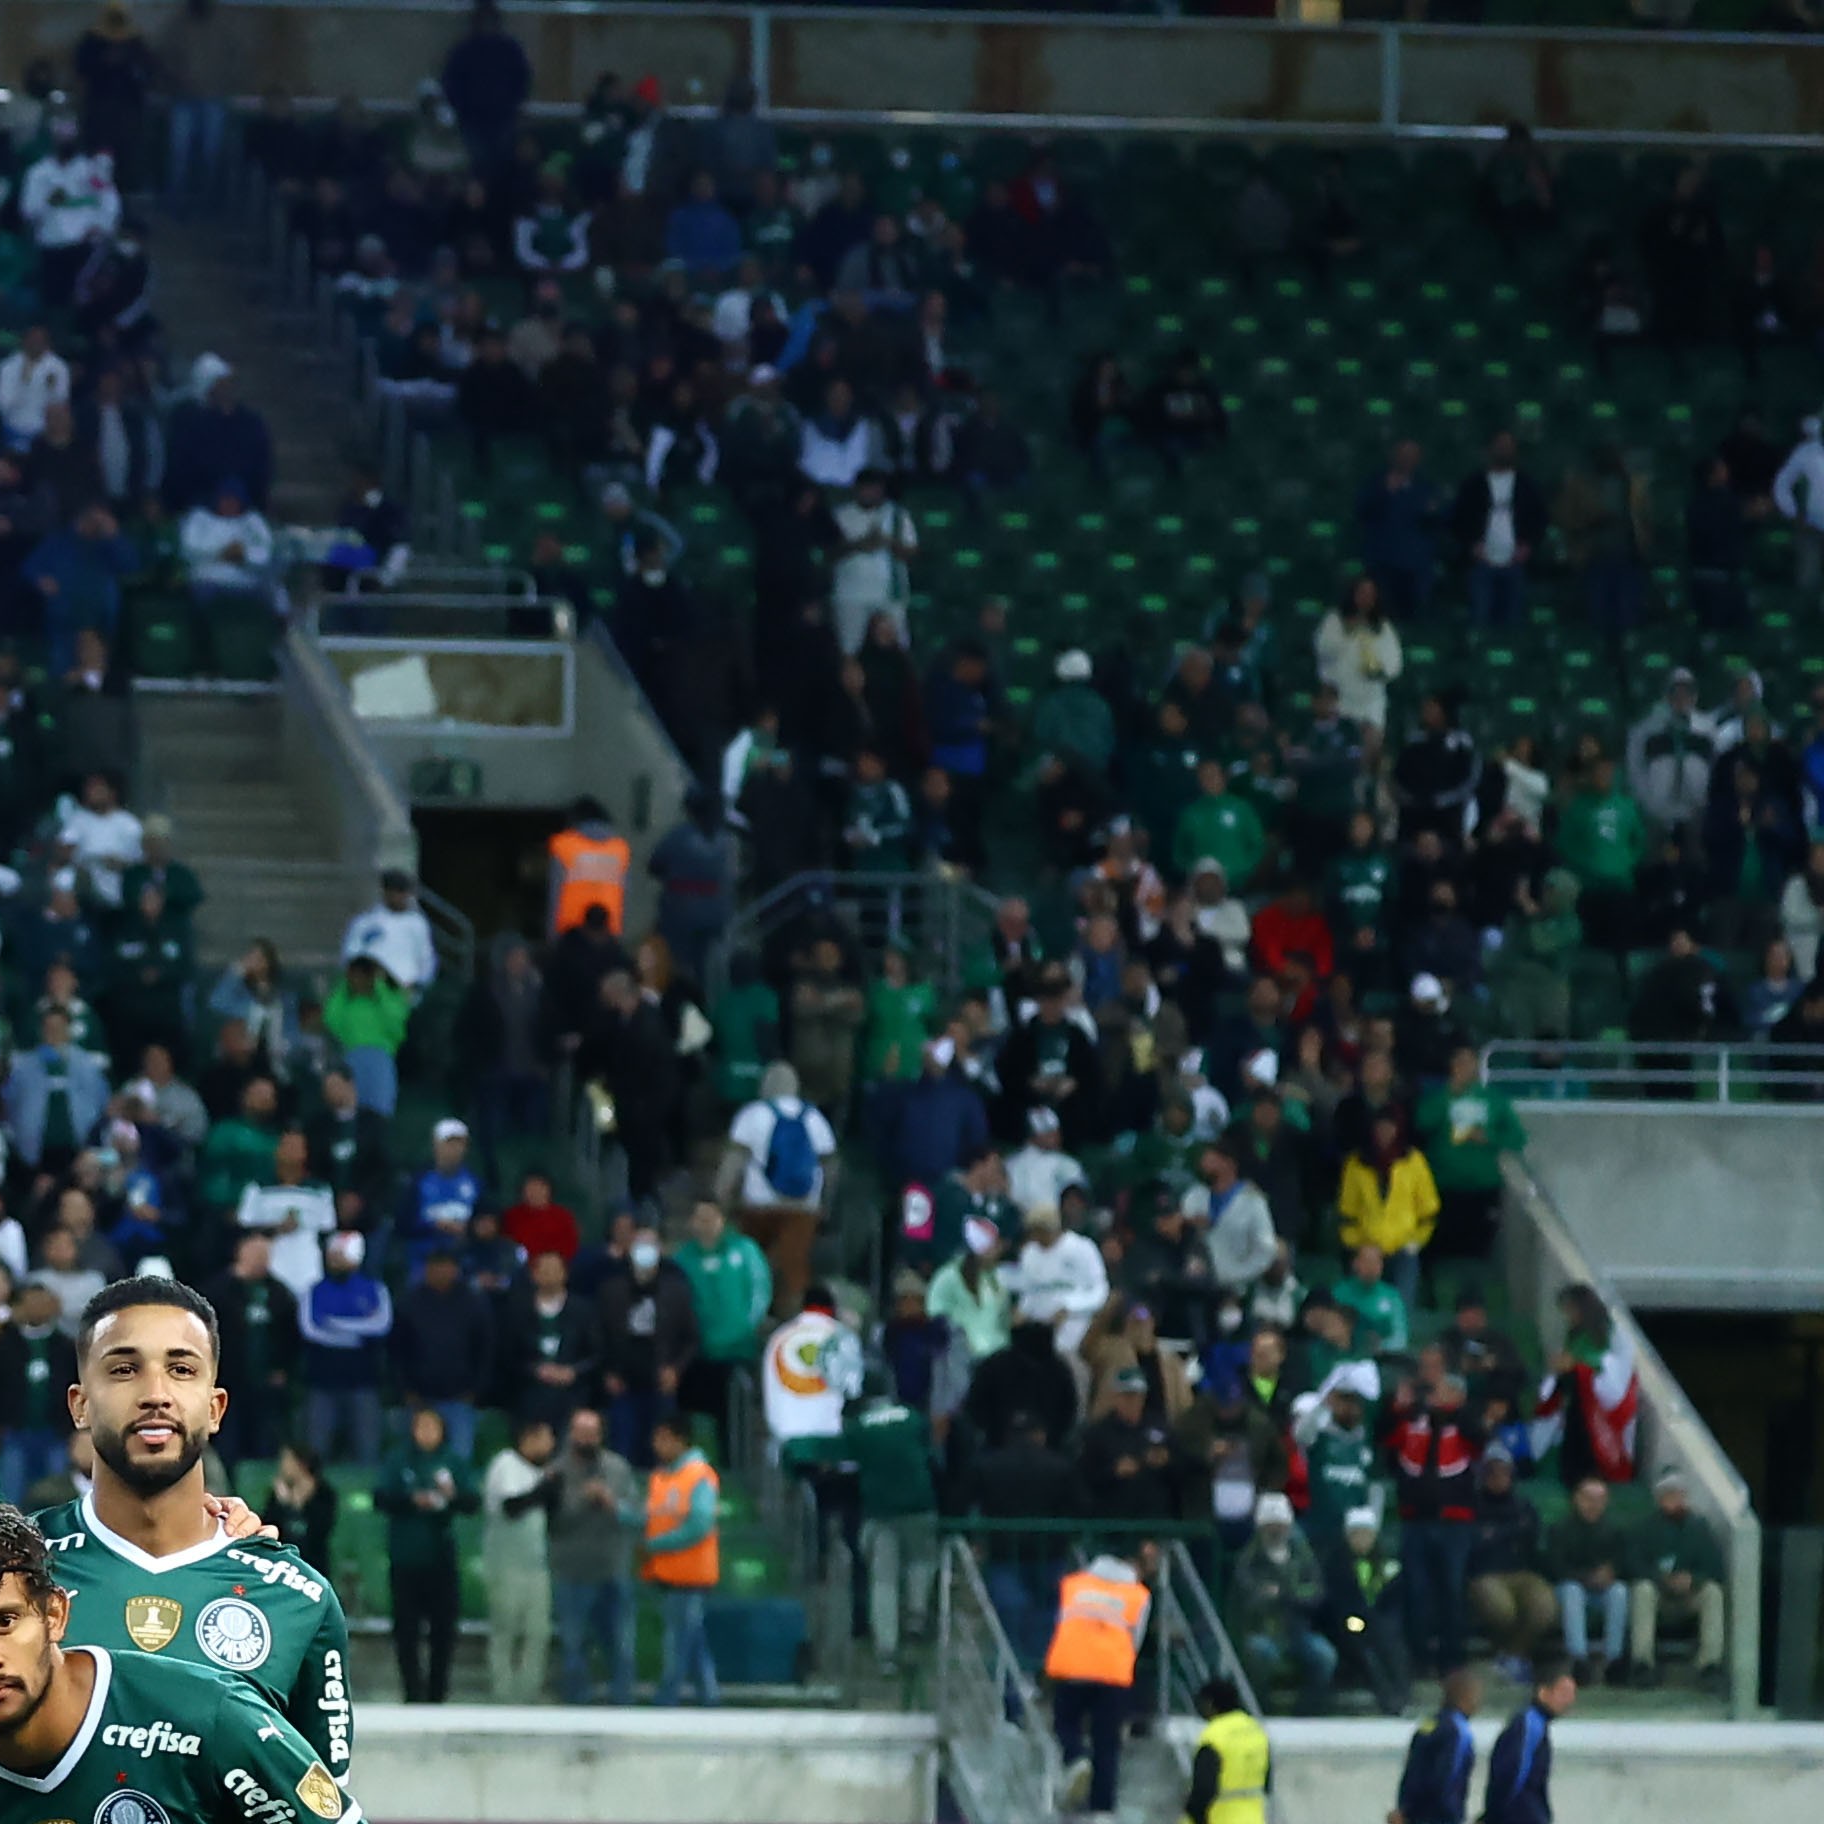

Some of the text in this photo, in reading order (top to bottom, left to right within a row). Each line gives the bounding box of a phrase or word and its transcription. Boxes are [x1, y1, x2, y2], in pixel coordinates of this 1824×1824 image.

[227, 1548, 327, 1602] crefisa
[324, 1649, 351, 1763] crefisa
[102, 1721, 202, 1758] crefisa
